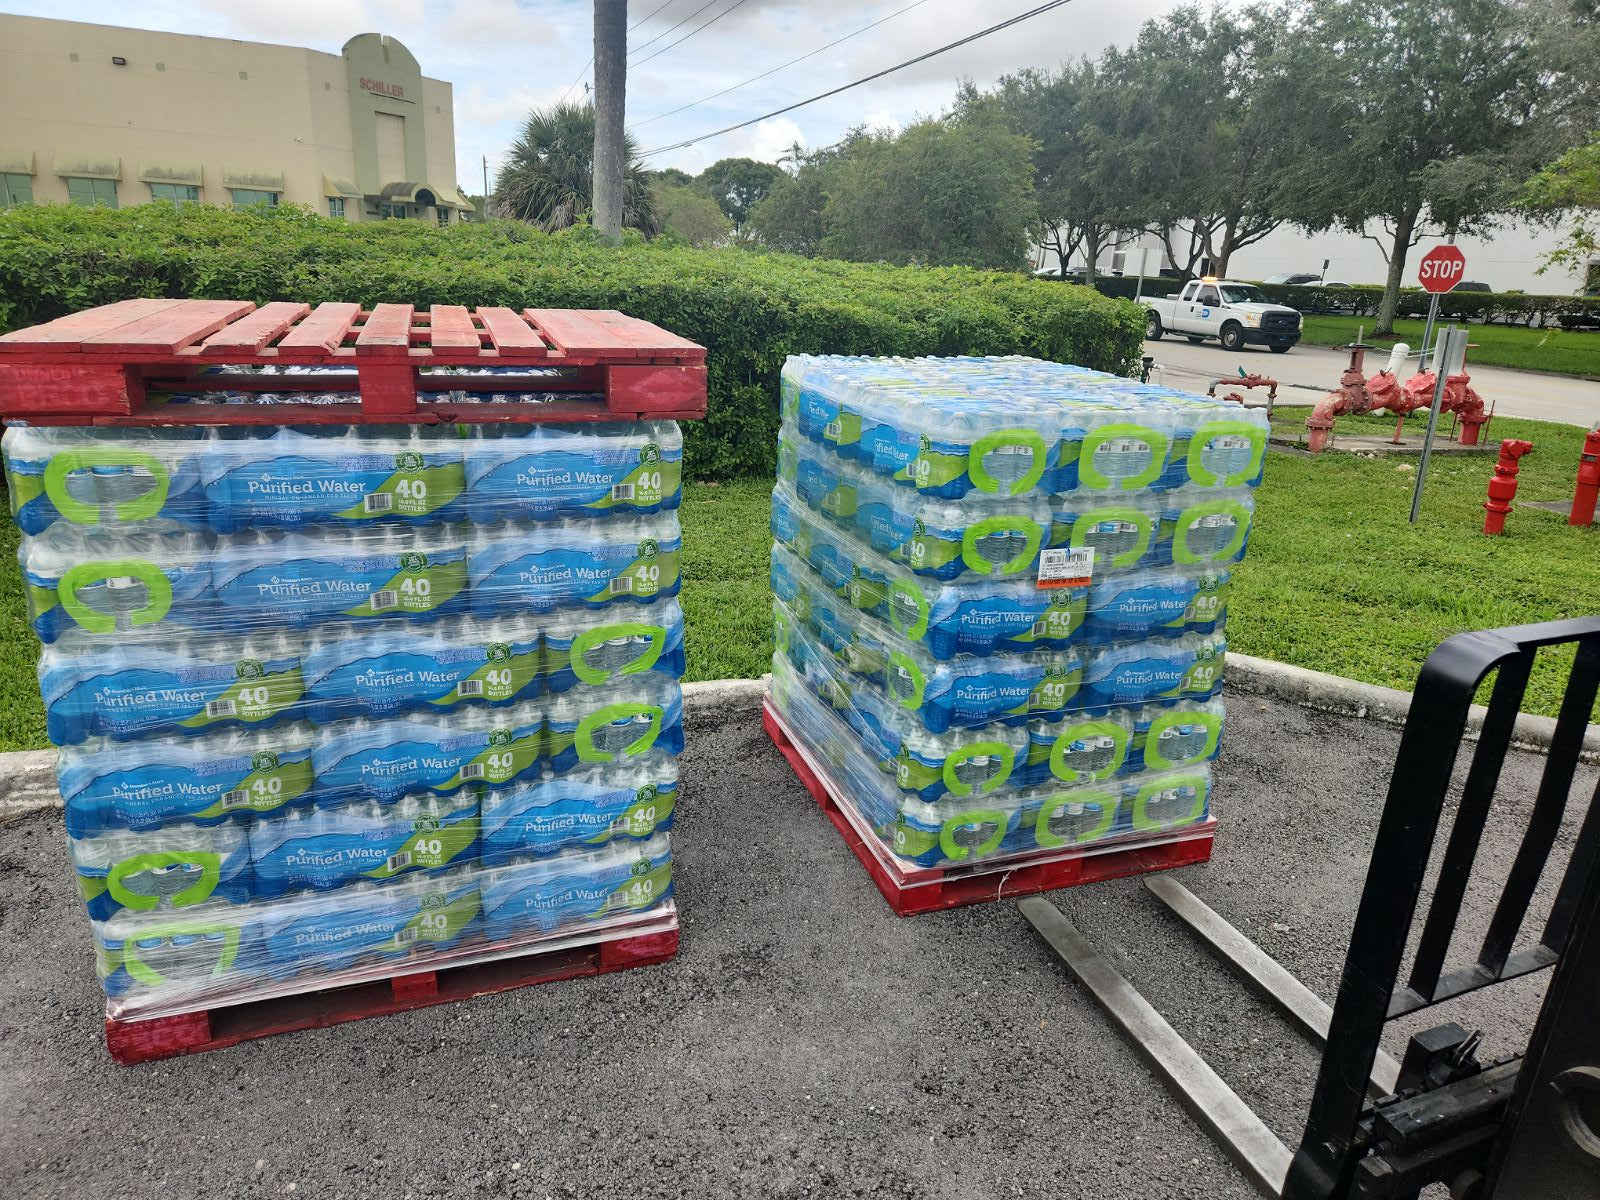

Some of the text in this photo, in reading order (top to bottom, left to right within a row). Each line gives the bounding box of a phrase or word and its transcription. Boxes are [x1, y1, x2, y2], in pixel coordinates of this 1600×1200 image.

[359, 77, 404, 97] SCHILLER
[1421, 260, 1463, 279] STOP
[247, 480, 366, 494] Purified Water
[516, 471, 614, 486] Purified Water
[637, 471, 661, 490] 40
[395, 479, 427, 499] 40
[398, 504, 427, 512] BOTTLES
[520, 567, 612, 584] Purified Water
[635, 565, 660, 582] 40
[258, 580, 372, 596] Purified Water
[399, 577, 431, 596] 40
[1119, 601, 1158, 612] Purified
[1197, 595, 1218, 609] 40
[961, 612, 1035, 625] Purified Water
[1048, 611, 1071, 626] 40
[355, 671, 460, 687] Purified Water
[485, 668, 512, 686] 40
[1116, 673, 1154, 684] Purified
[1193, 666, 1214, 680] 40
[238, 686, 269, 705] 40
[956, 686, 1029, 700] Purified Water
[1042, 682, 1065, 697] 40
[94, 690, 207, 707] Purified Water
[361, 757, 462, 776] Purified Water
[487, 752, 513, 769] 40
[111, 783, 223, 800] Purified Water
[252, 776, 282, 795] 40
[525, 813, 613, 832] Purified Water
[633, 806, 656, 823] 40
[413, 839, 442, 855] 40
[286, 851, 344, 866] Purified
[346, 848, 389, 859] Water
[631, 879, 653, 896] 40
[525, 887, 609, 909] Purified Water
[421, 912, 448, 929] 40
[295, 923, 396, 944] Purified Water
